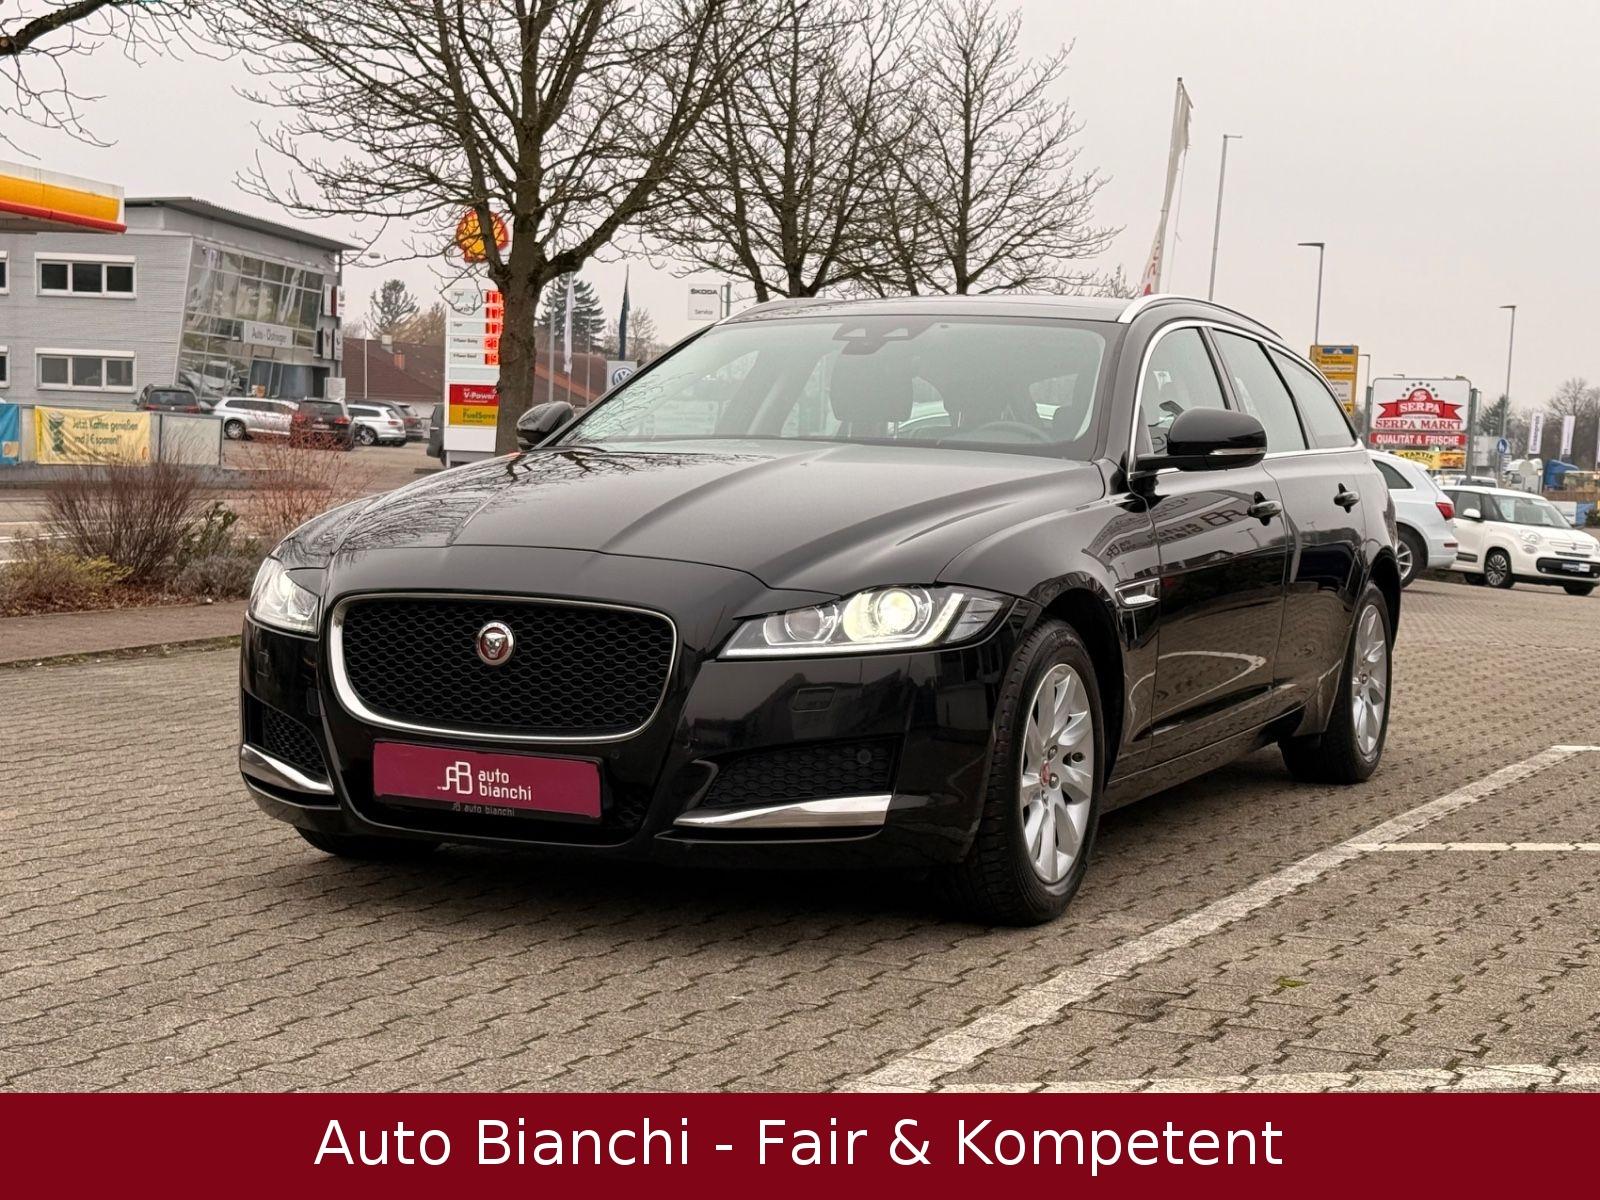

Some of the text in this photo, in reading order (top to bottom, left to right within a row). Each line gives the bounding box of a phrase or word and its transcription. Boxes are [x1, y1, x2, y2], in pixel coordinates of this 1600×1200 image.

[463, 391, 496, 400] V-Power
[1400, 401, 1440, 414] SERPA
[1376, 420, 1463, 430] SERPA MARKT
[1426, 435, 1459, 445] FRISCHE
[478, 768, 510, 784] auto
[479, 781, 532, 801] bianchi
[464, 805, 482, 813] auto
[485, 805, 515, 817] bianchi
